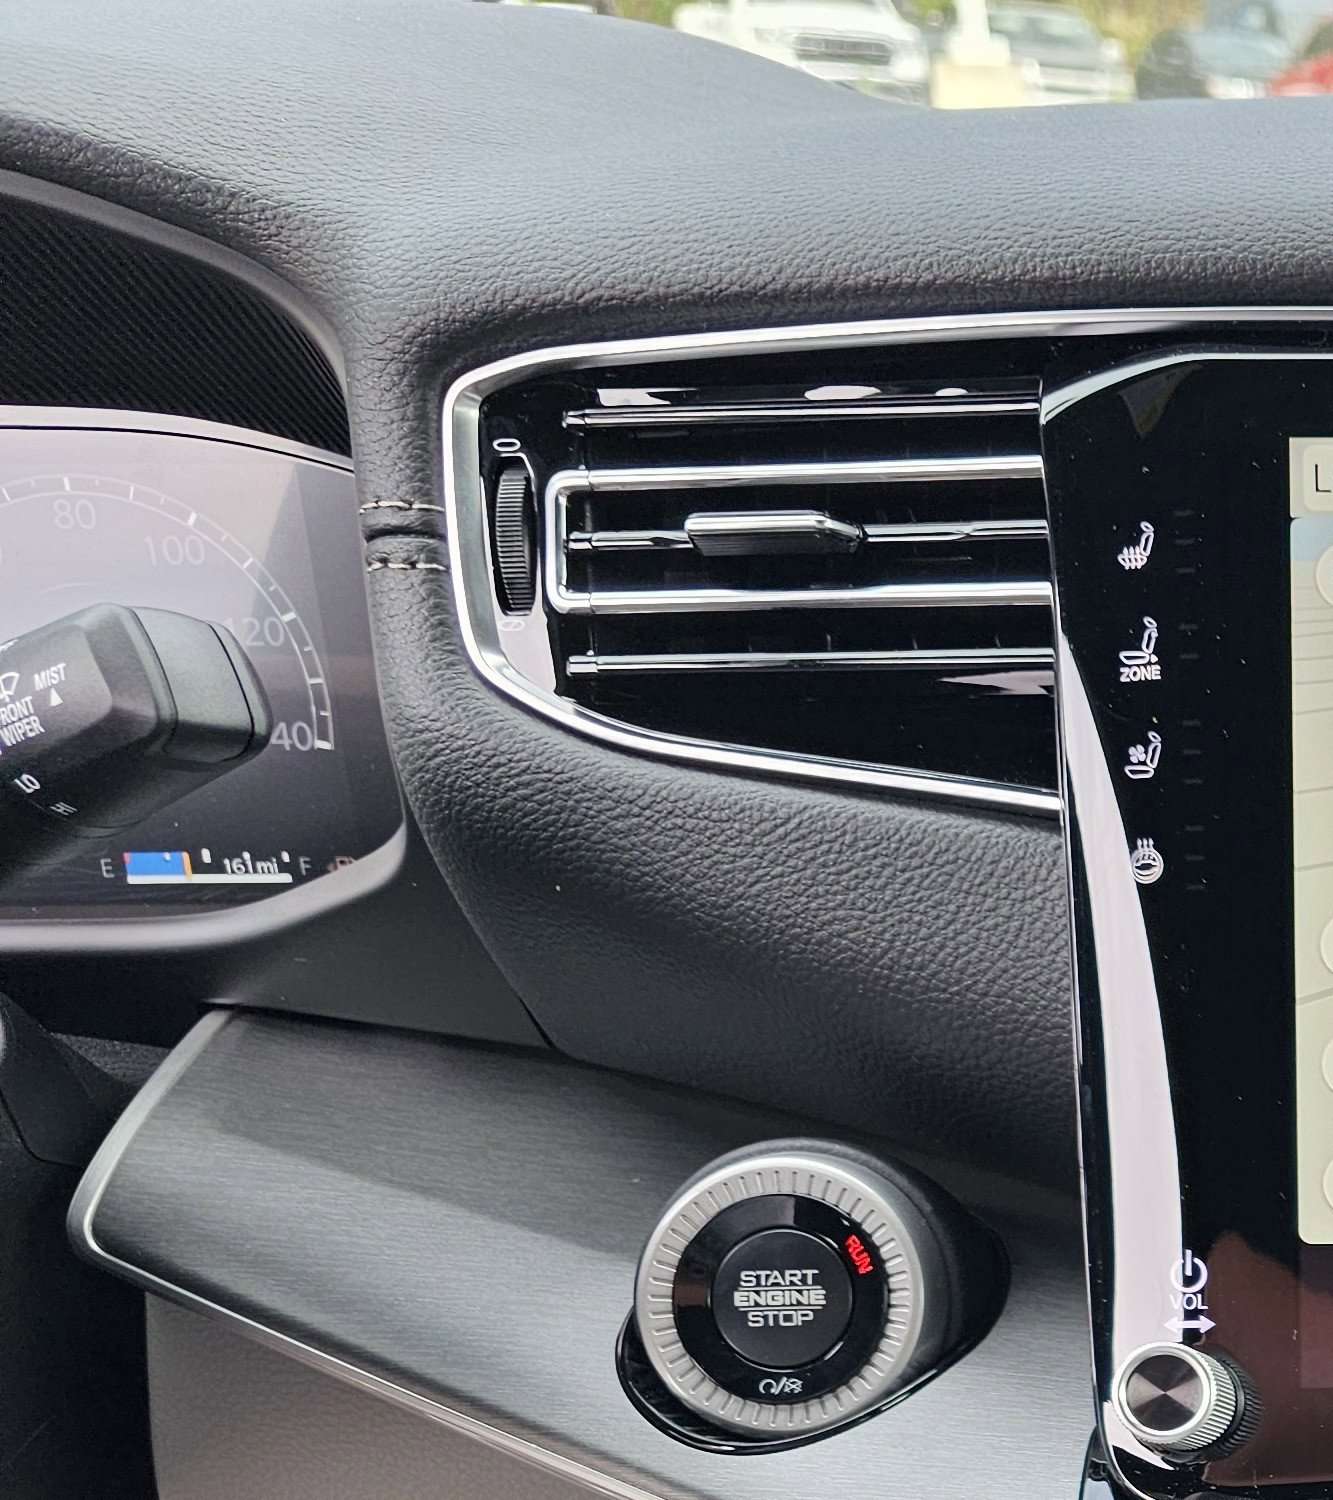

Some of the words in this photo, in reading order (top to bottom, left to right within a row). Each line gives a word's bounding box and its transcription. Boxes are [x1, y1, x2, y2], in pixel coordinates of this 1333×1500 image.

[53, 500, 97, 529] 80
[144, 535, 205, 565] 100
[34, 663, 66, 691] MIST
[1120, 665, 1161, 681] ZONE
[0, 696, 34, 725] RONT
[0, 716, 45, 747] WIPER
[269, 721, 312, 750] 40
[14, 773, 41, 793] LO
[100, 858, 115, 879] E
[256, 857, 278, 875] mi
[300, 857, 312, 876] F
[845, 1235, 874, 1274] RUN
[740, 1269, 819, 1286] START
[733, 1290, 826, 1307] ENGINE
[1169, 1294, 1208, 1310] VOL
[748, 1310, 814, 1327] STOP
